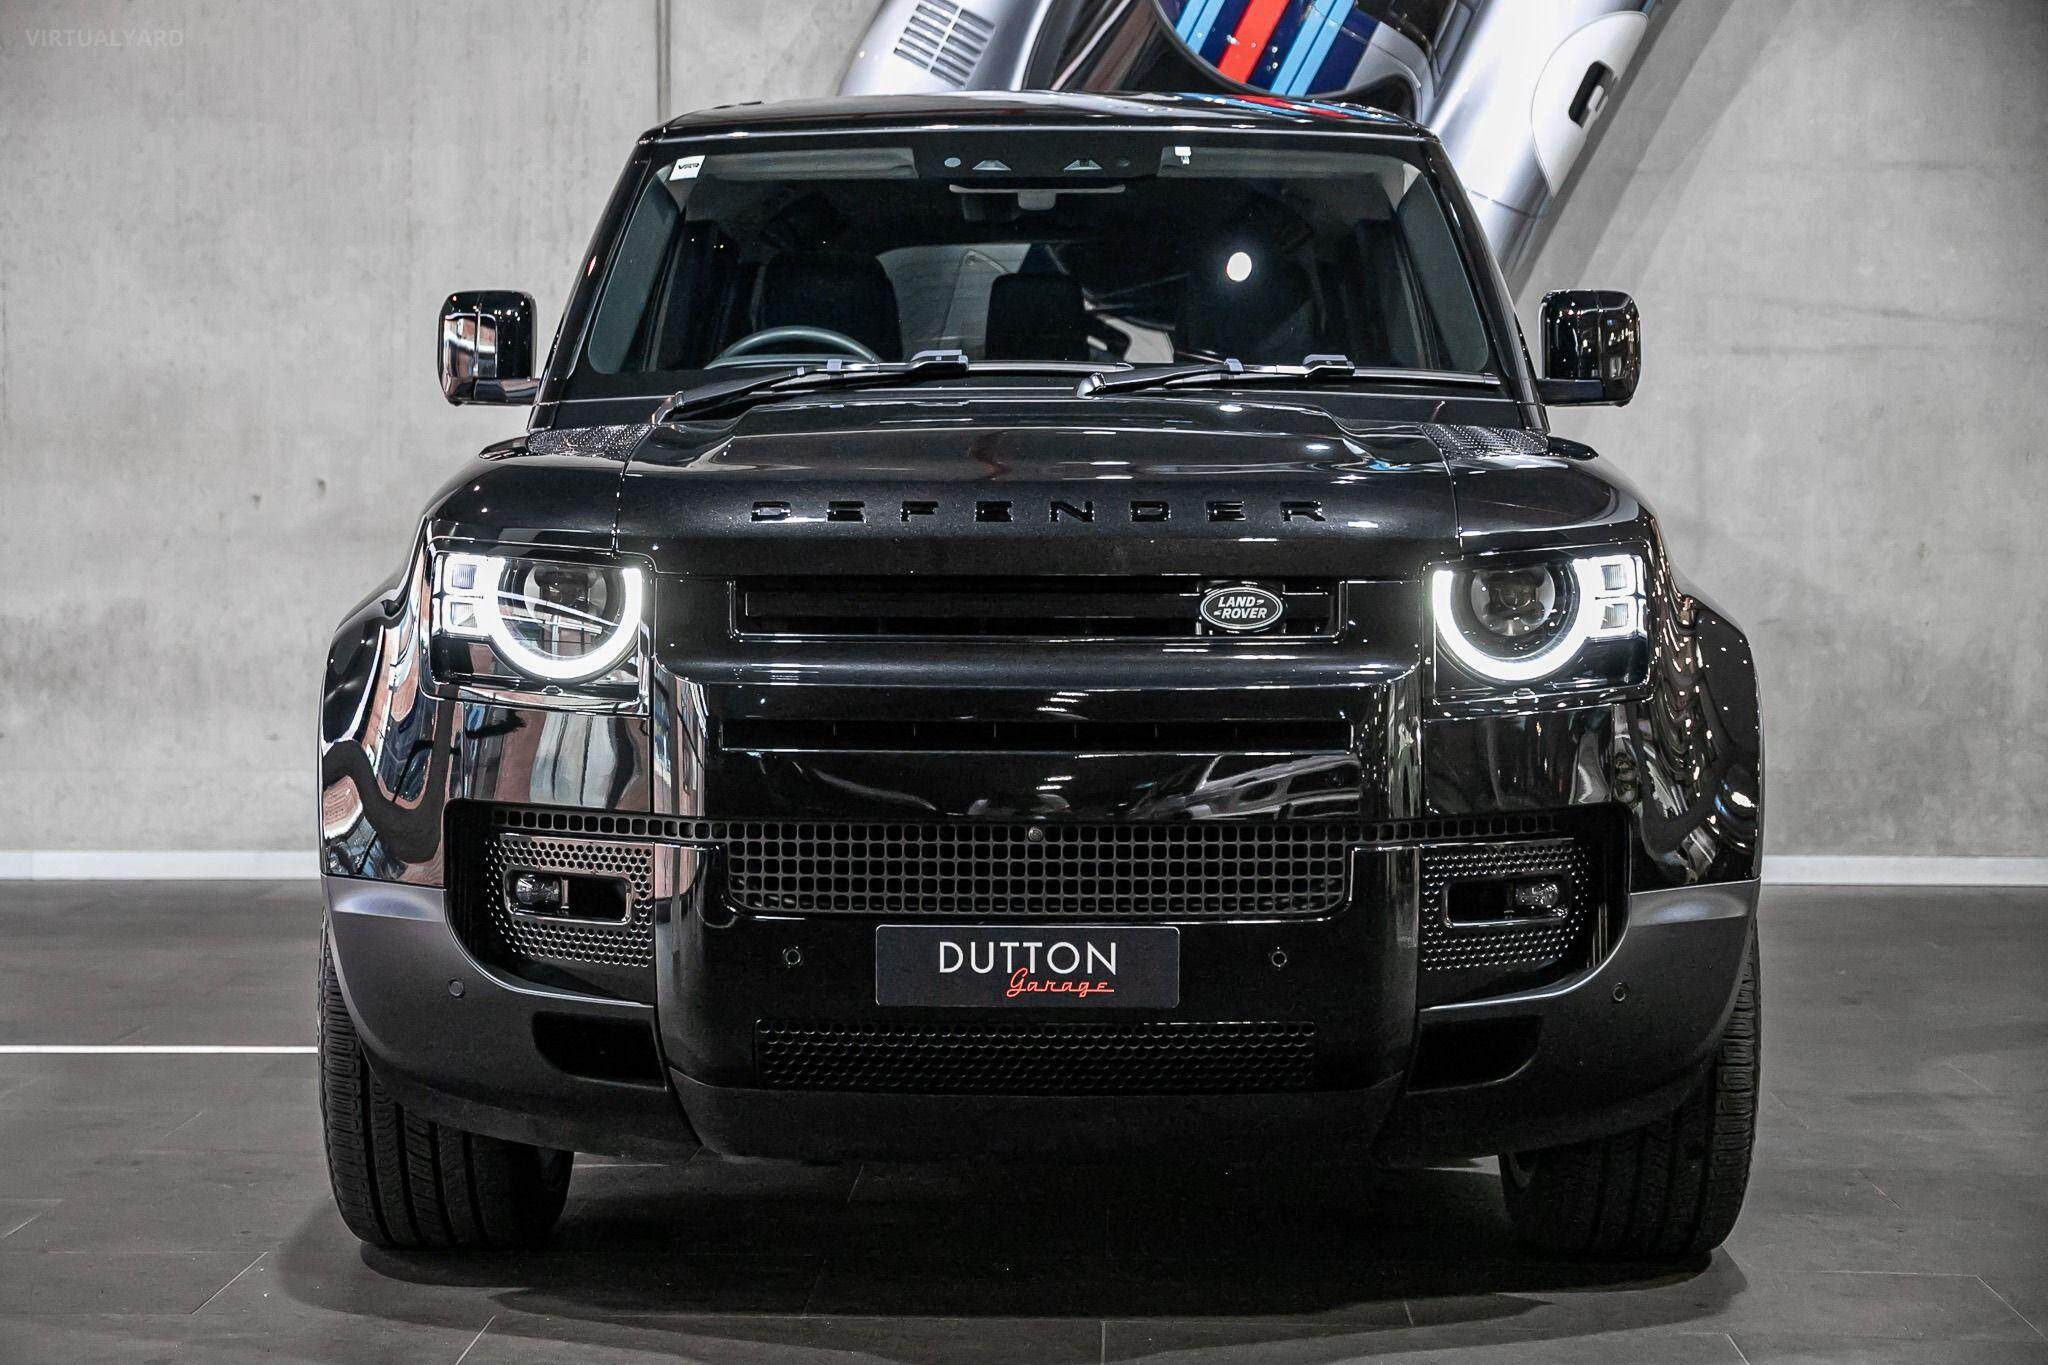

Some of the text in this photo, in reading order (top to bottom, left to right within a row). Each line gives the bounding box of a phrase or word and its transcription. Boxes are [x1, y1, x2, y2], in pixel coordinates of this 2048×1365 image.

[751, 500, 1326, 523] DEFENDER
[1218, 596, 1256, 607] LAND
[1221, 607, 1267, 619] ROVER
[939, 941, 1117, 975] DUTTON
[1006, 967, 1115, 998] Garage
